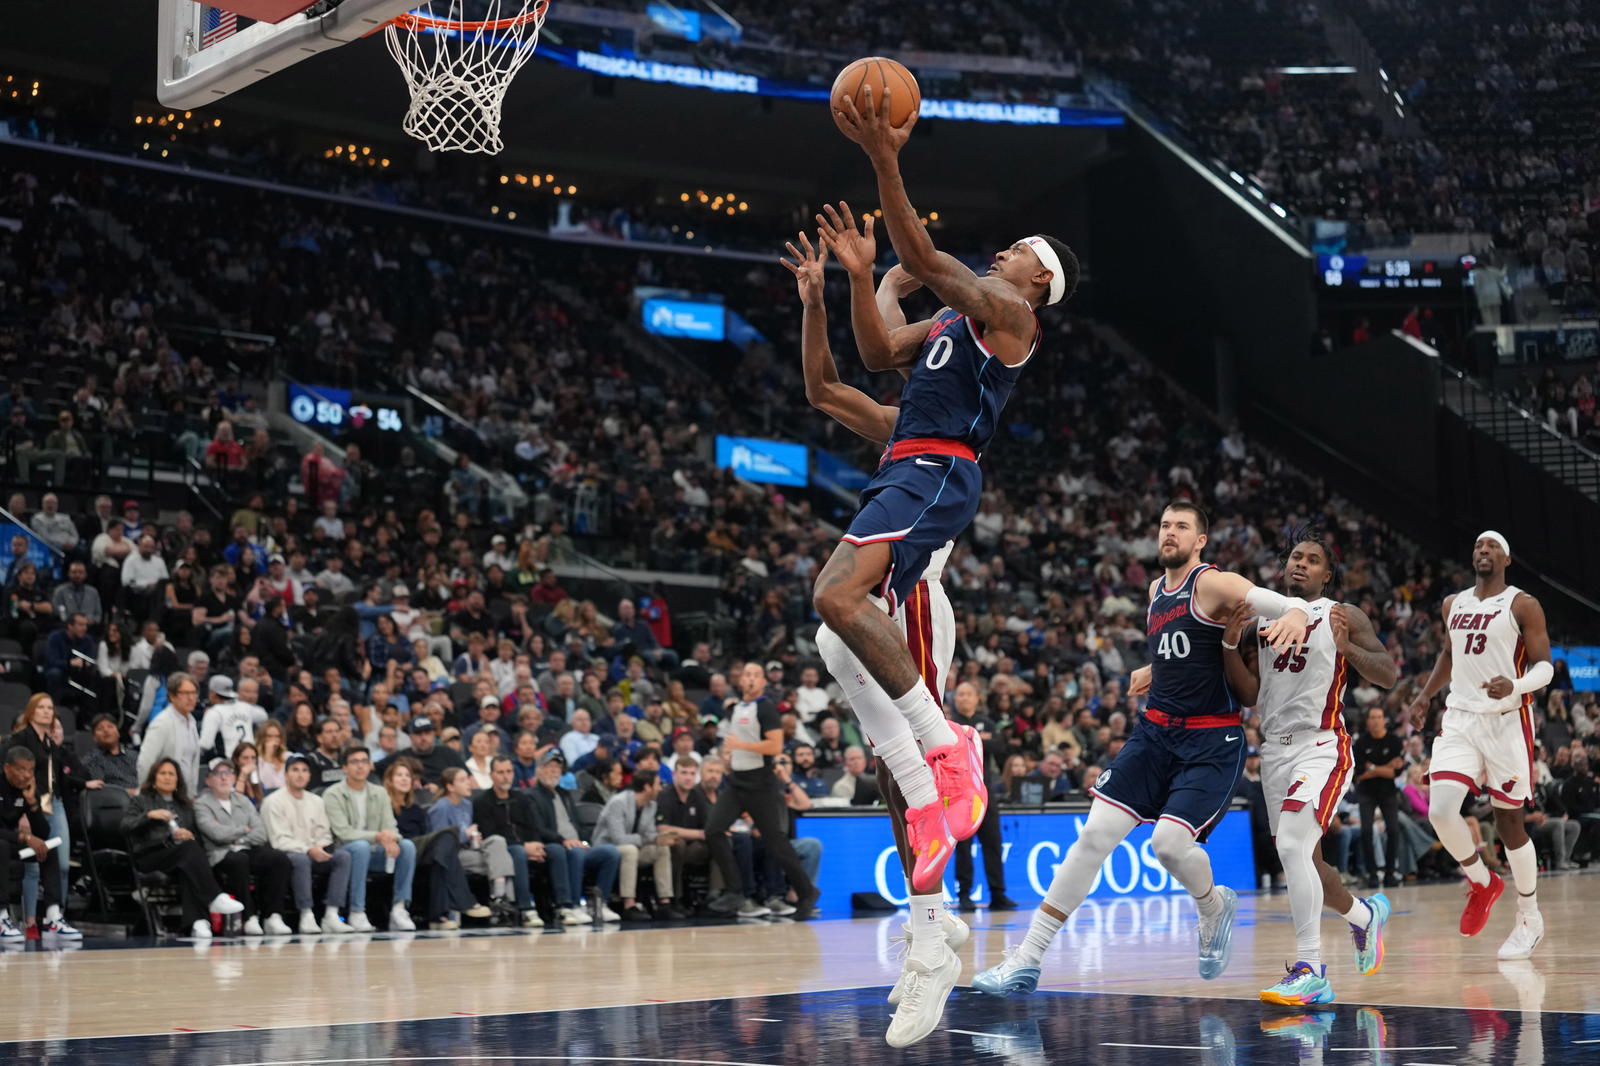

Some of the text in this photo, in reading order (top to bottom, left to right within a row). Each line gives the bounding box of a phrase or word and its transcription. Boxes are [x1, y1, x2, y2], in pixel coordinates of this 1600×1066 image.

[577, 50, 758, 93] MEDICAL EXCELLENCE
[953, 101, 1061, 124] EXCELLENCE
[926, 335, 953, 370] 0
[316, 400, 342, 425] 50
[377, 408, 402, 432] 54
[1450, 609, 1501, 630] HEAT
[1158, 631, 1191, 660] 40
[1464, 633, 1487, 655] 13
[1273, 646, 1309, 673] 45
